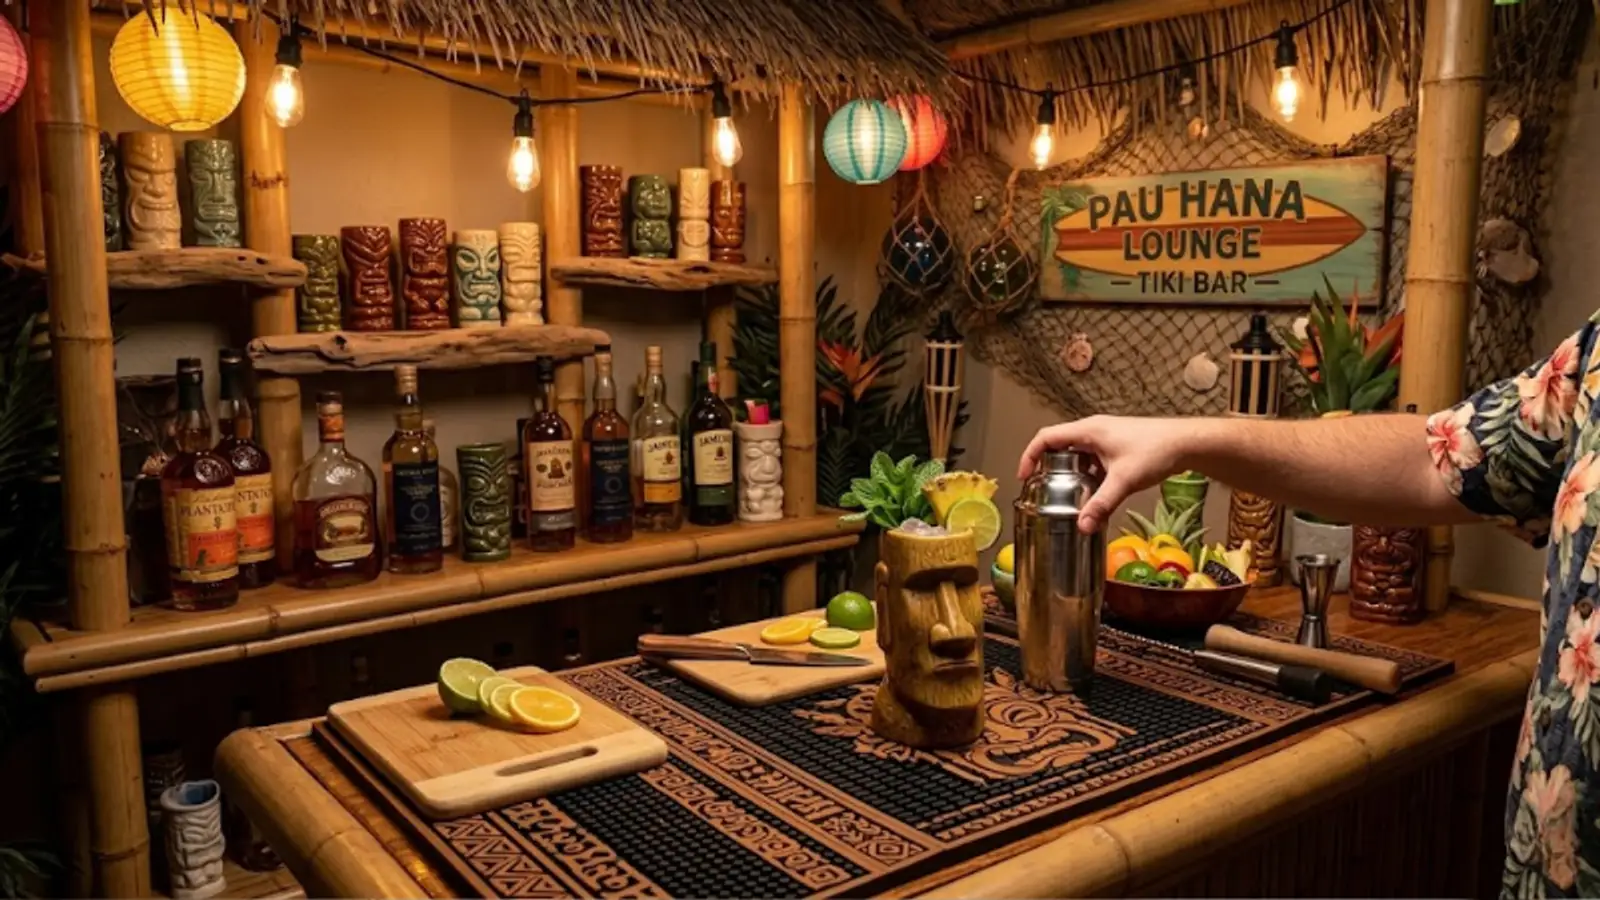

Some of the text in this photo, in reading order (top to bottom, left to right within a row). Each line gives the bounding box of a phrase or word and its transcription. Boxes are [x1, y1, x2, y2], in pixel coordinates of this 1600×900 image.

[1089, 178, 1305, 231] PAU HANA
[1123, 228, 1262, 262] LOUNGE
[1138, 271, 1247, 294] TIKI BAR
